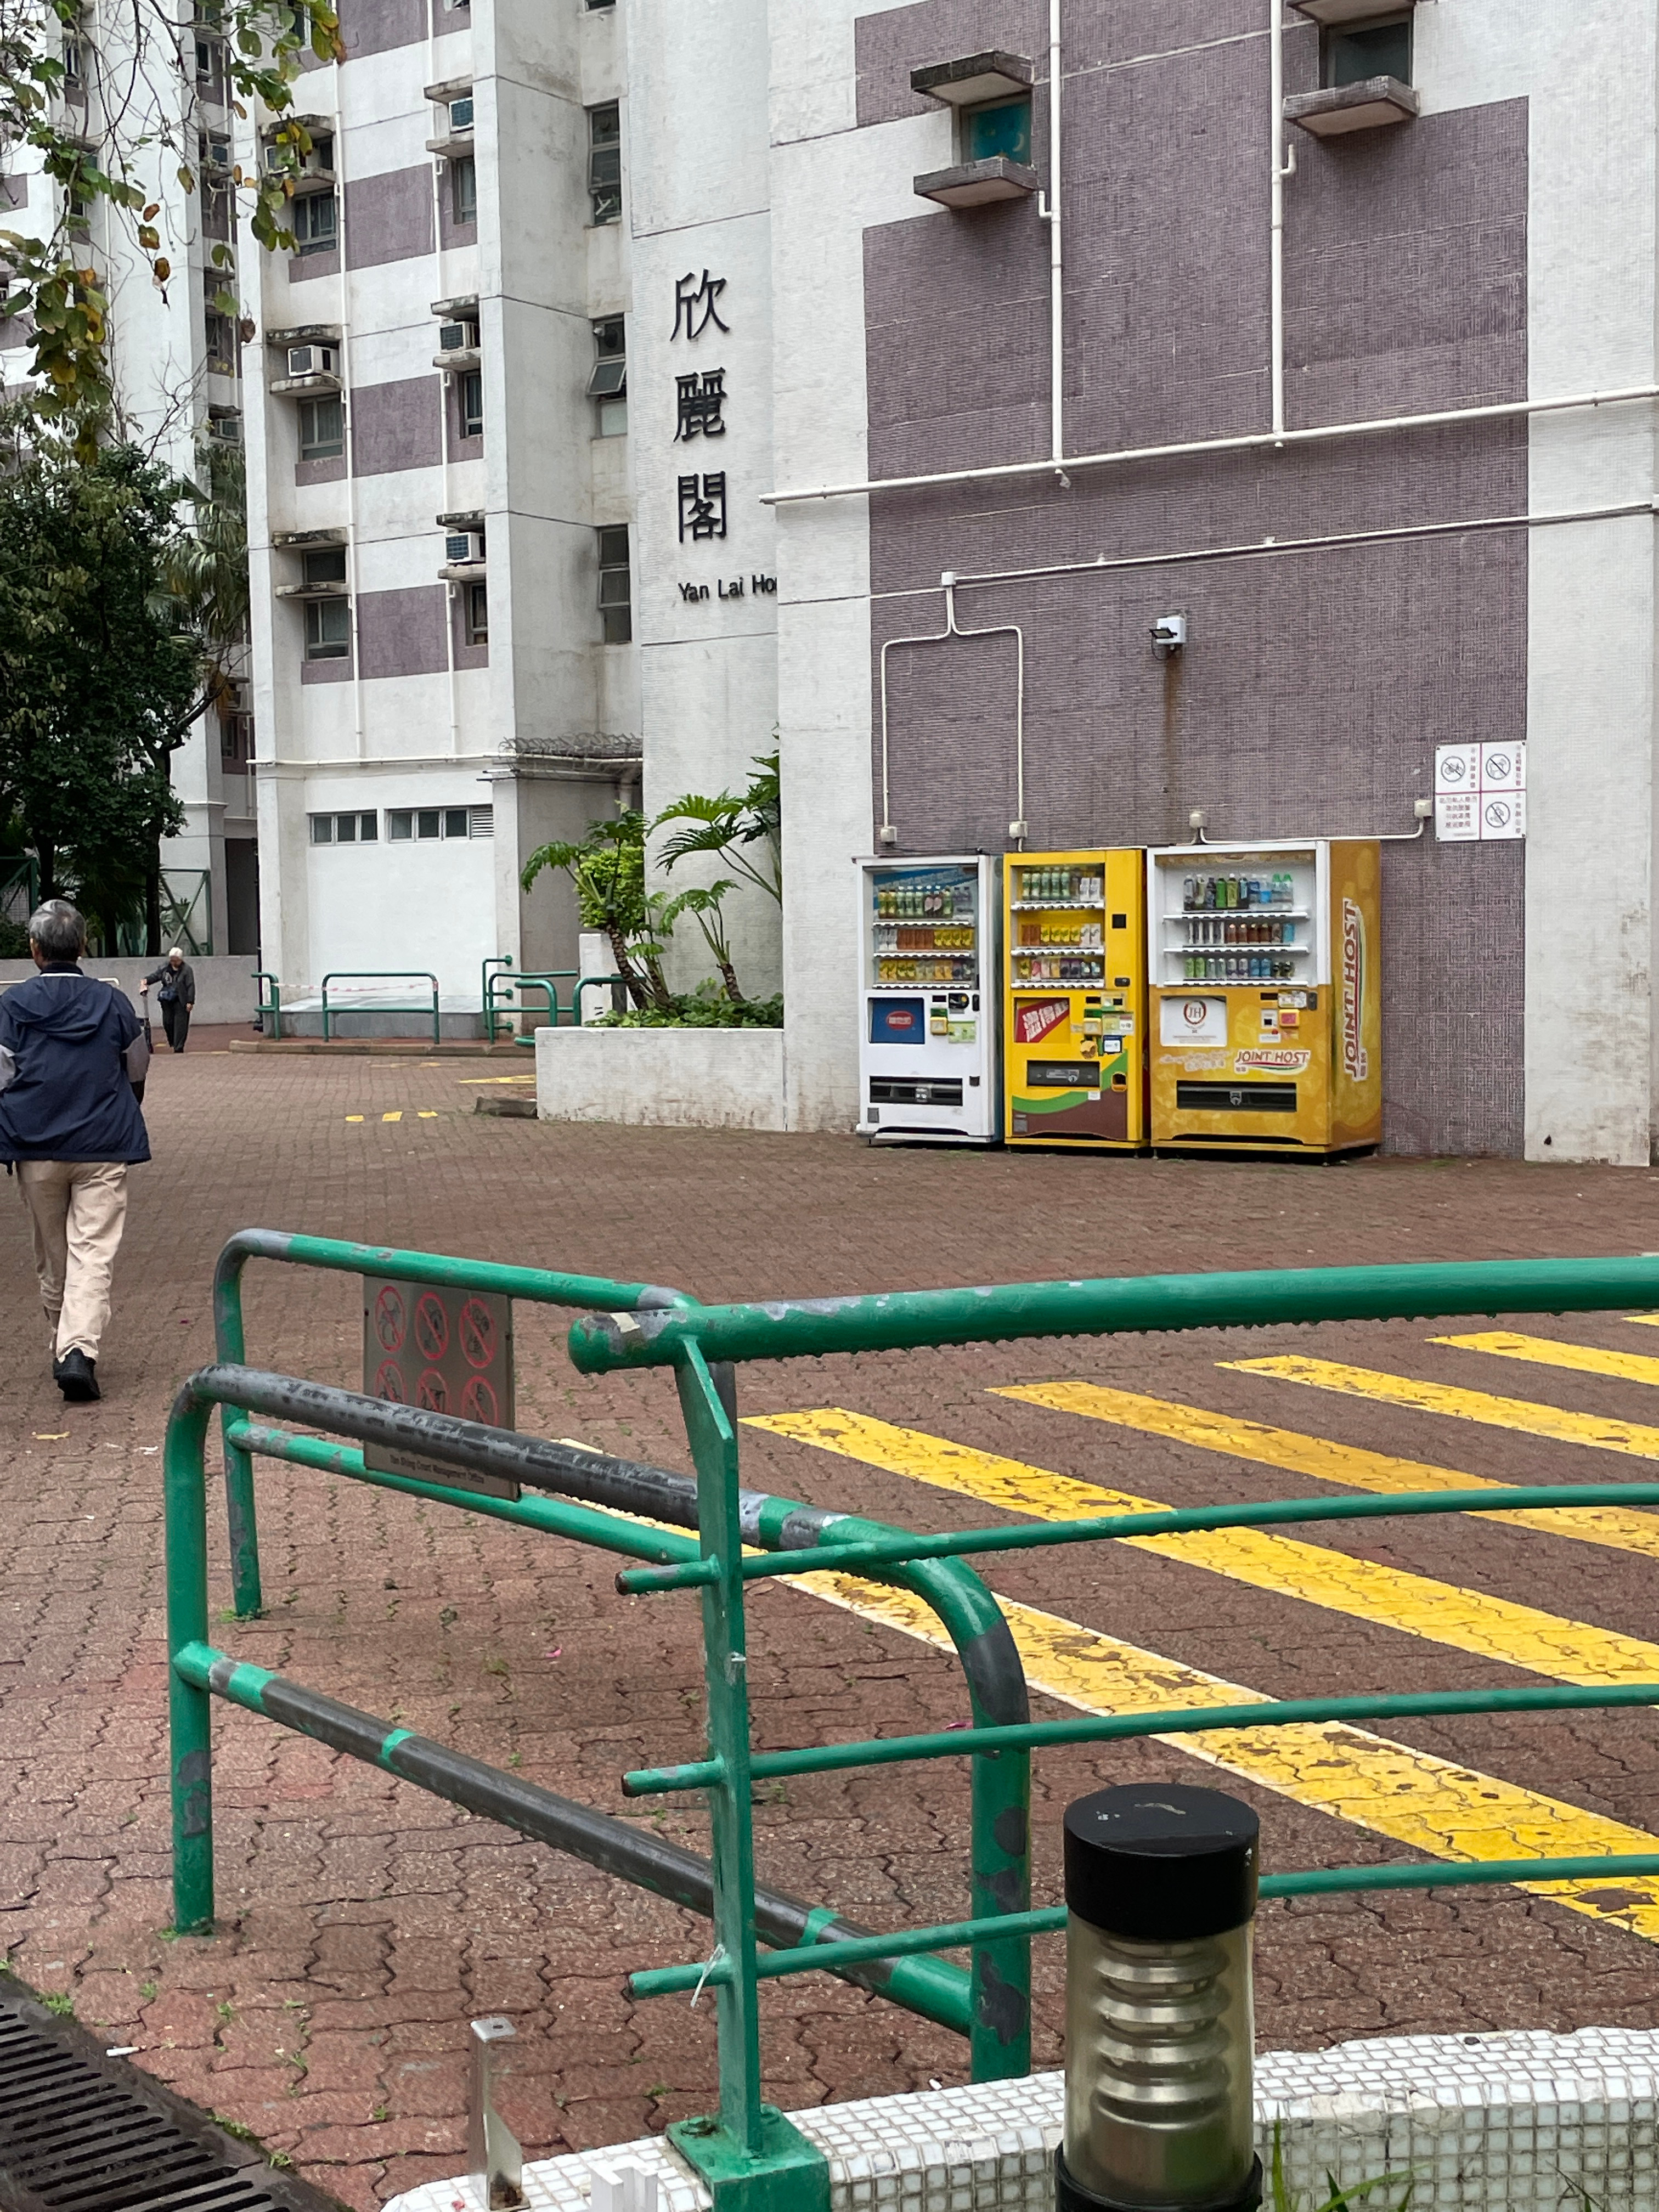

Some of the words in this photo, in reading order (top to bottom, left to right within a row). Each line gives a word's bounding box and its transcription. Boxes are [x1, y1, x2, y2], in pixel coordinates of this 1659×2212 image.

[670, 268, 731, 544] 欣麗閣
[678, 582, 710, 602] Yan
[718, 577, 744, 599] Lai
[751, 574, 777, 594] Ho
[1344, 900, 1357, 981] HOST
[1235, 1050, 1272, 1063] JOINT
[1274, 1051, 1310, 1063] HOST
[1344, 990, 1357, 1078] JOINT
